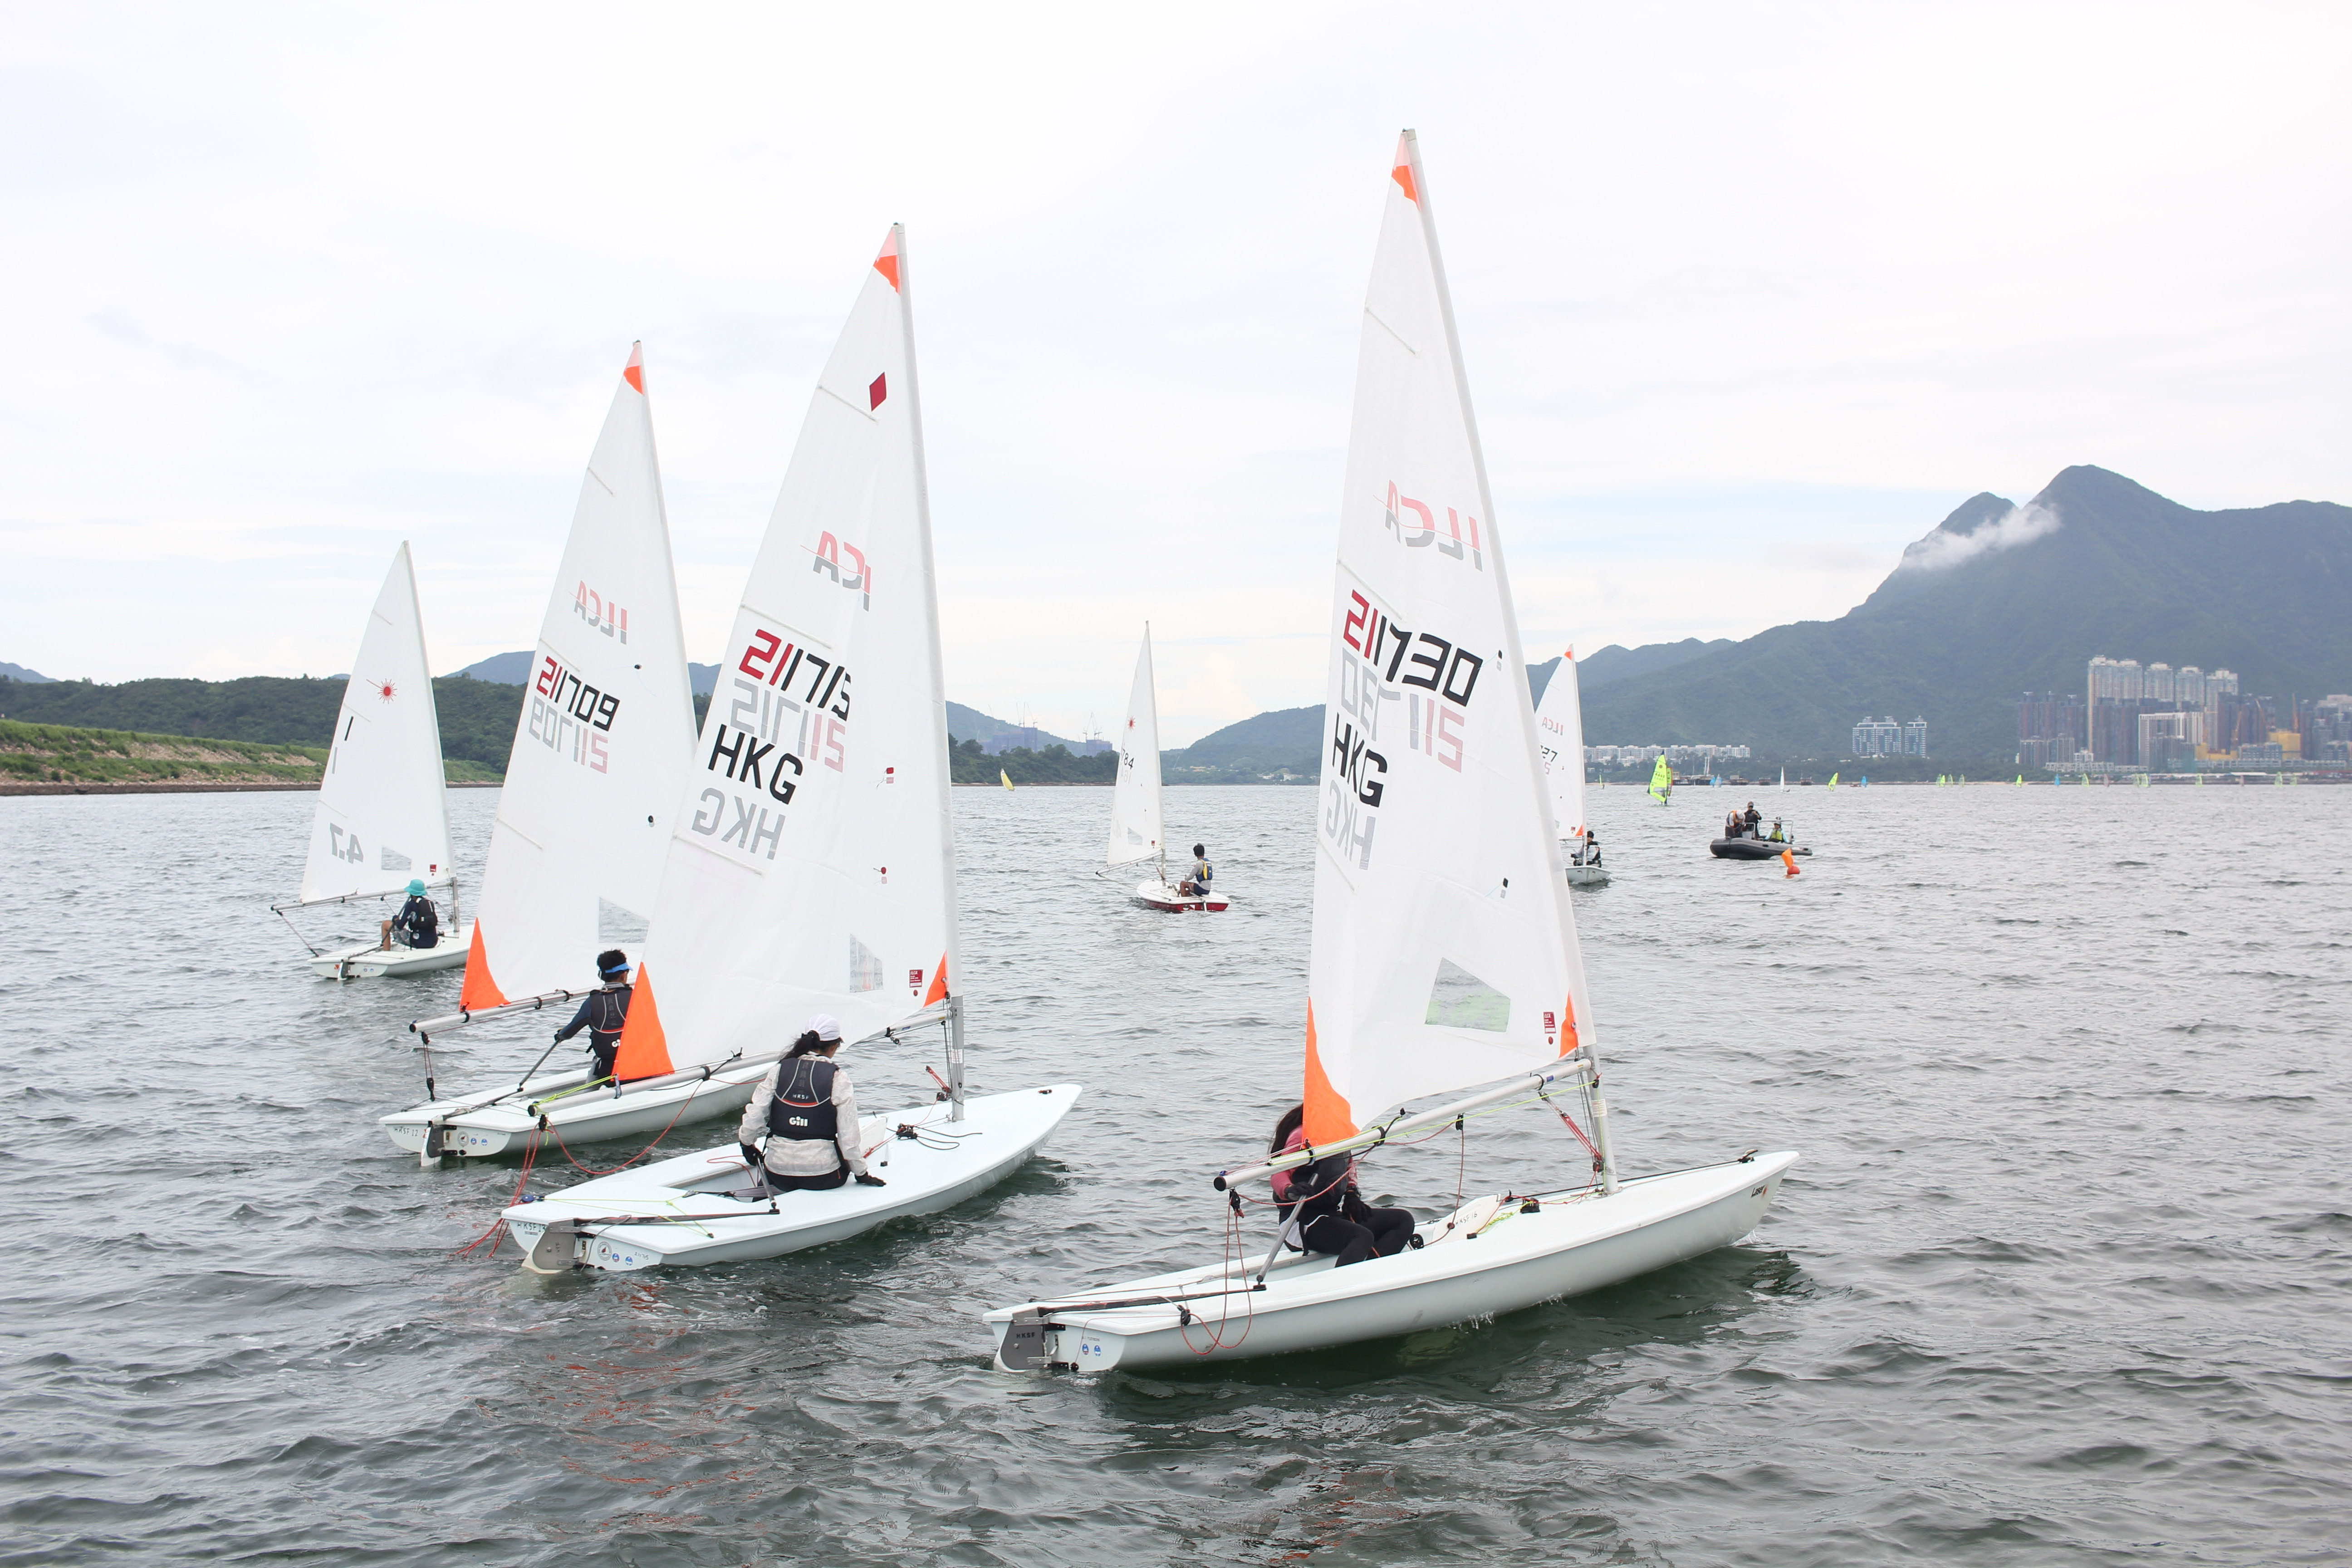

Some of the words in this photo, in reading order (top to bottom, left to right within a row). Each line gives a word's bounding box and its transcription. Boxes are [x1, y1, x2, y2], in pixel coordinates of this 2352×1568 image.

[739, 629, 851, 721] 211715
[1343, 589, 1483, 707] 211730
[536, 656, 620, 731] 211709
[708, 724, 803, 804] HKG
[1333, 712, 1387, 808] HKG
[789, 1116, 808, 1127] Gill
